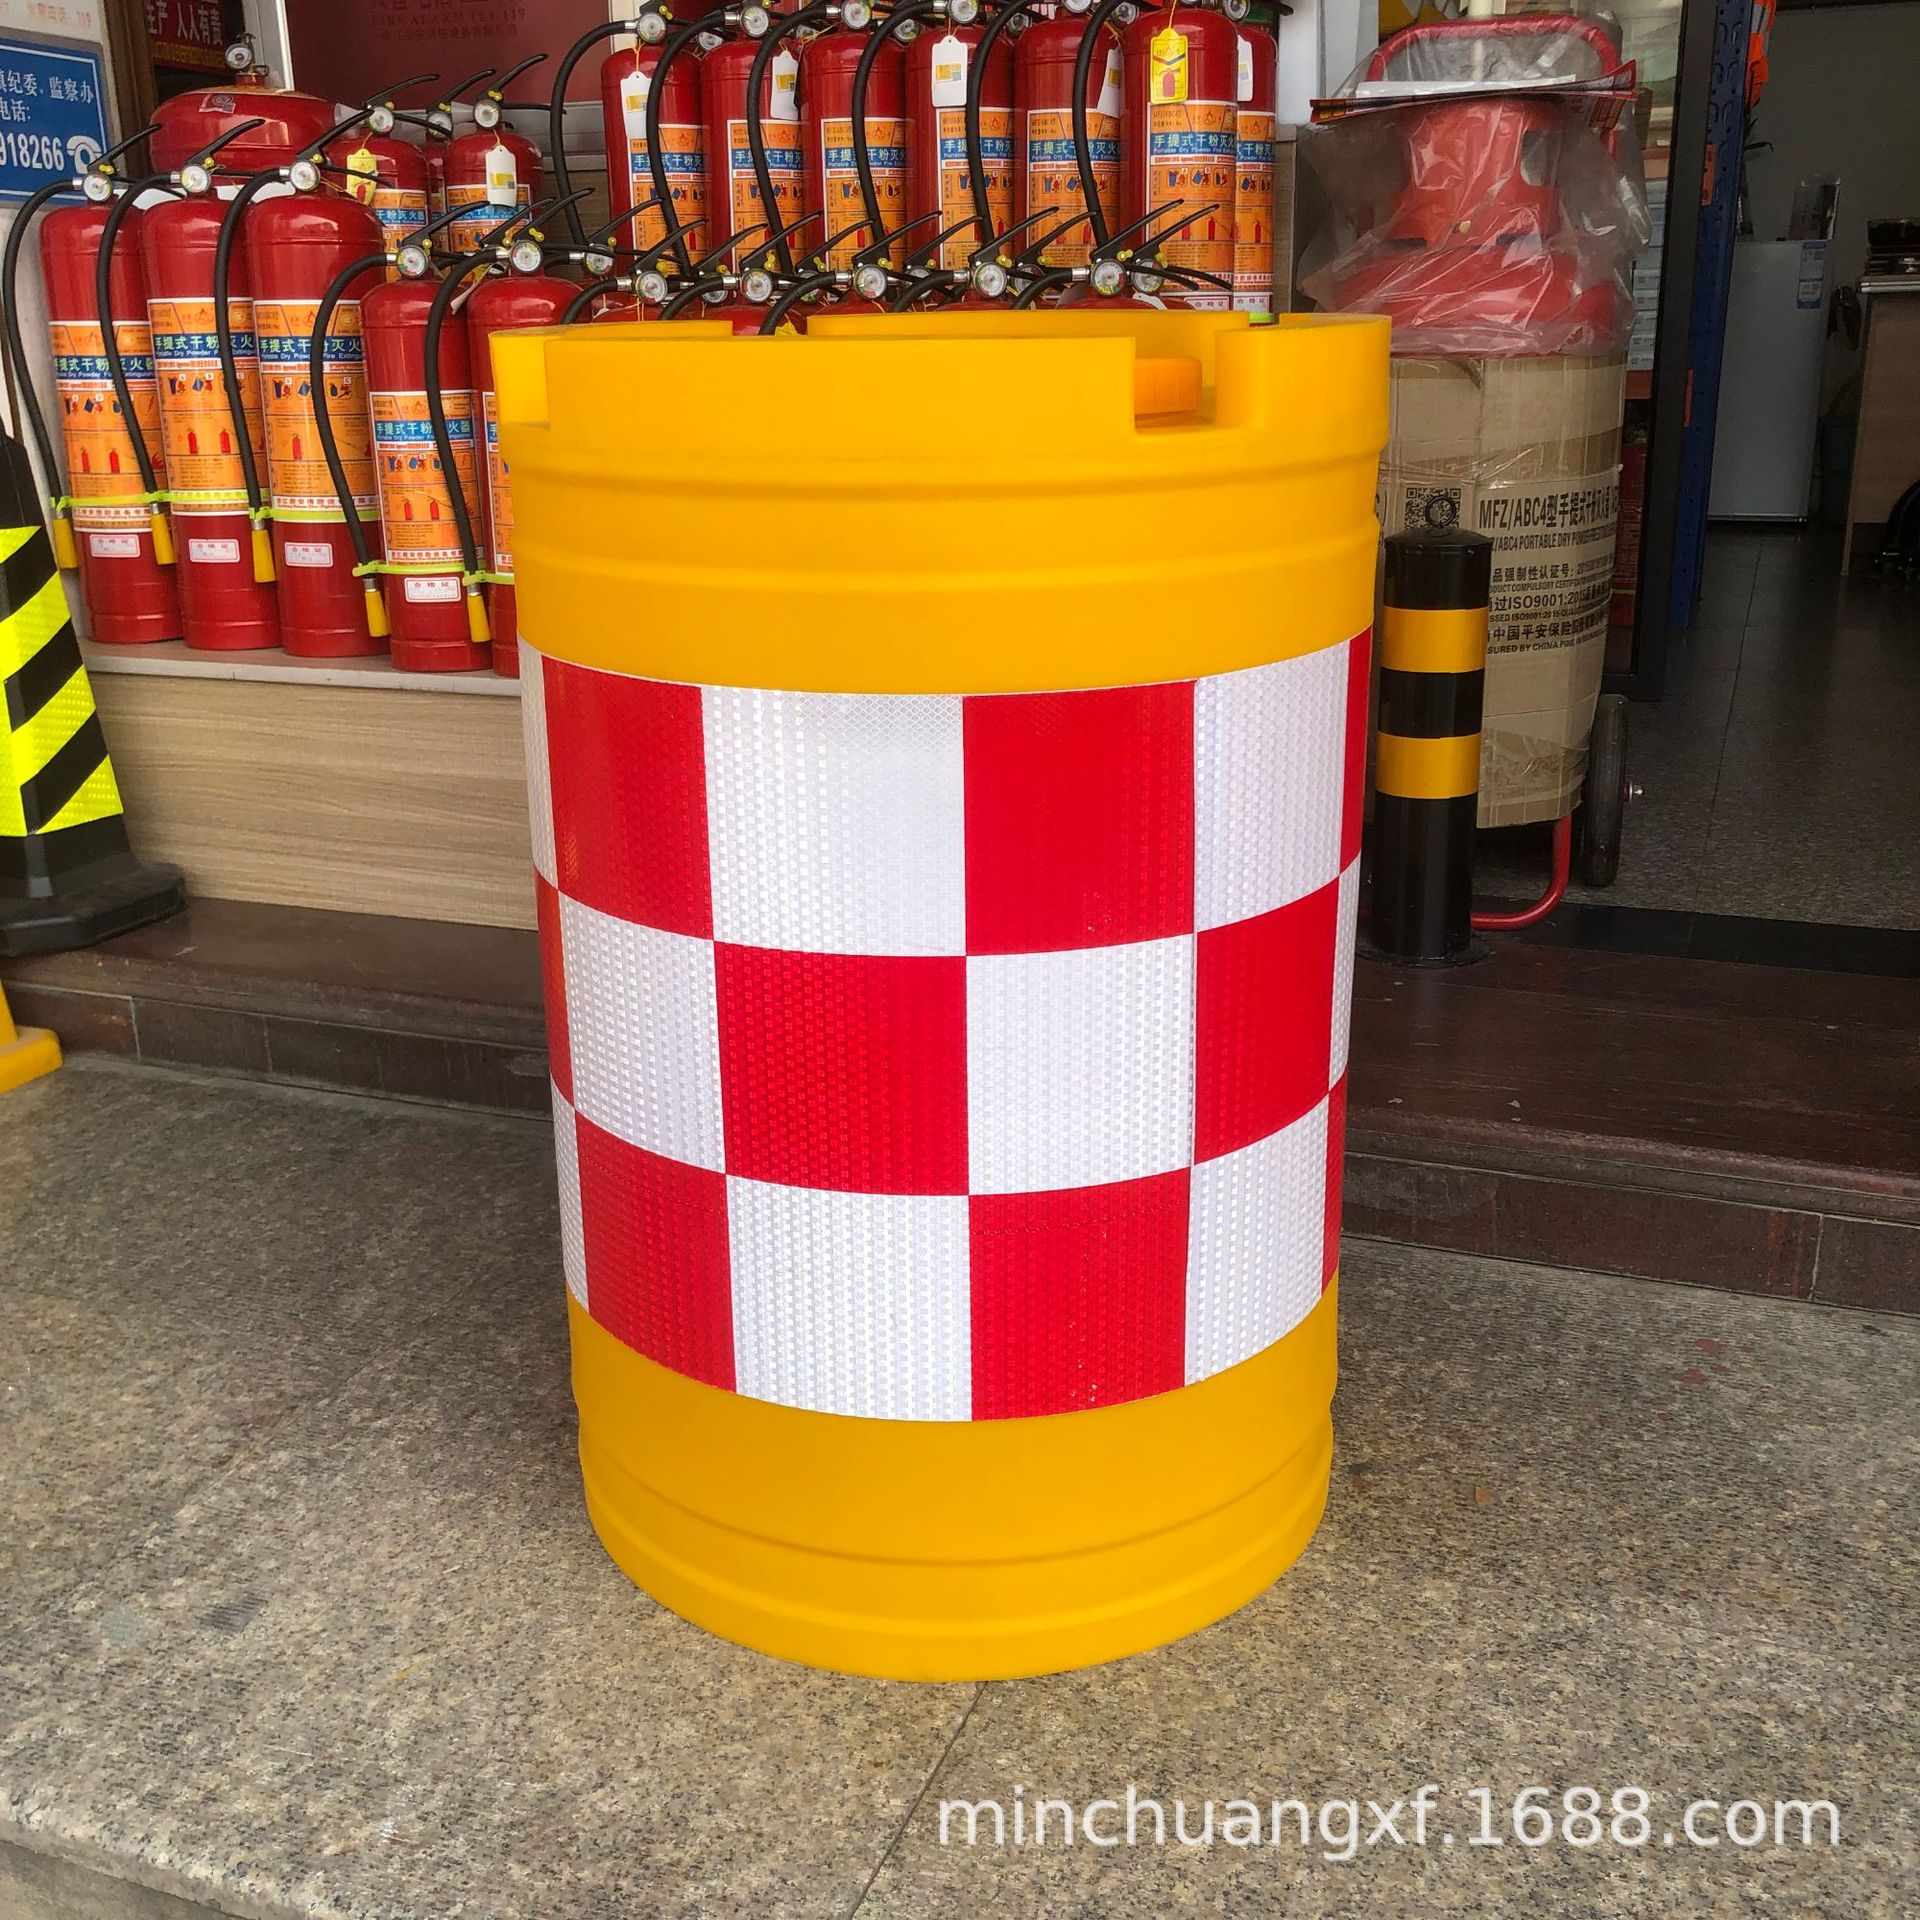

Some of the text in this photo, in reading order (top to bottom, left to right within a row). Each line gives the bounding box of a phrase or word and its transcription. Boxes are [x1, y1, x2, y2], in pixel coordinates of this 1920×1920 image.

[177, 3, 224, 46] 人人有责
[376, 420, 471, 435] 手提式干粉火器
[1519, 533, 1557, 550] PORTABLE
[1558, 531, 1571, 547] DRY
[1511, 581, 1554, 593] COMPULSORY
[1519, 644, 1531, 652] BY
[1532, 641, 1558, 651] CHINA
